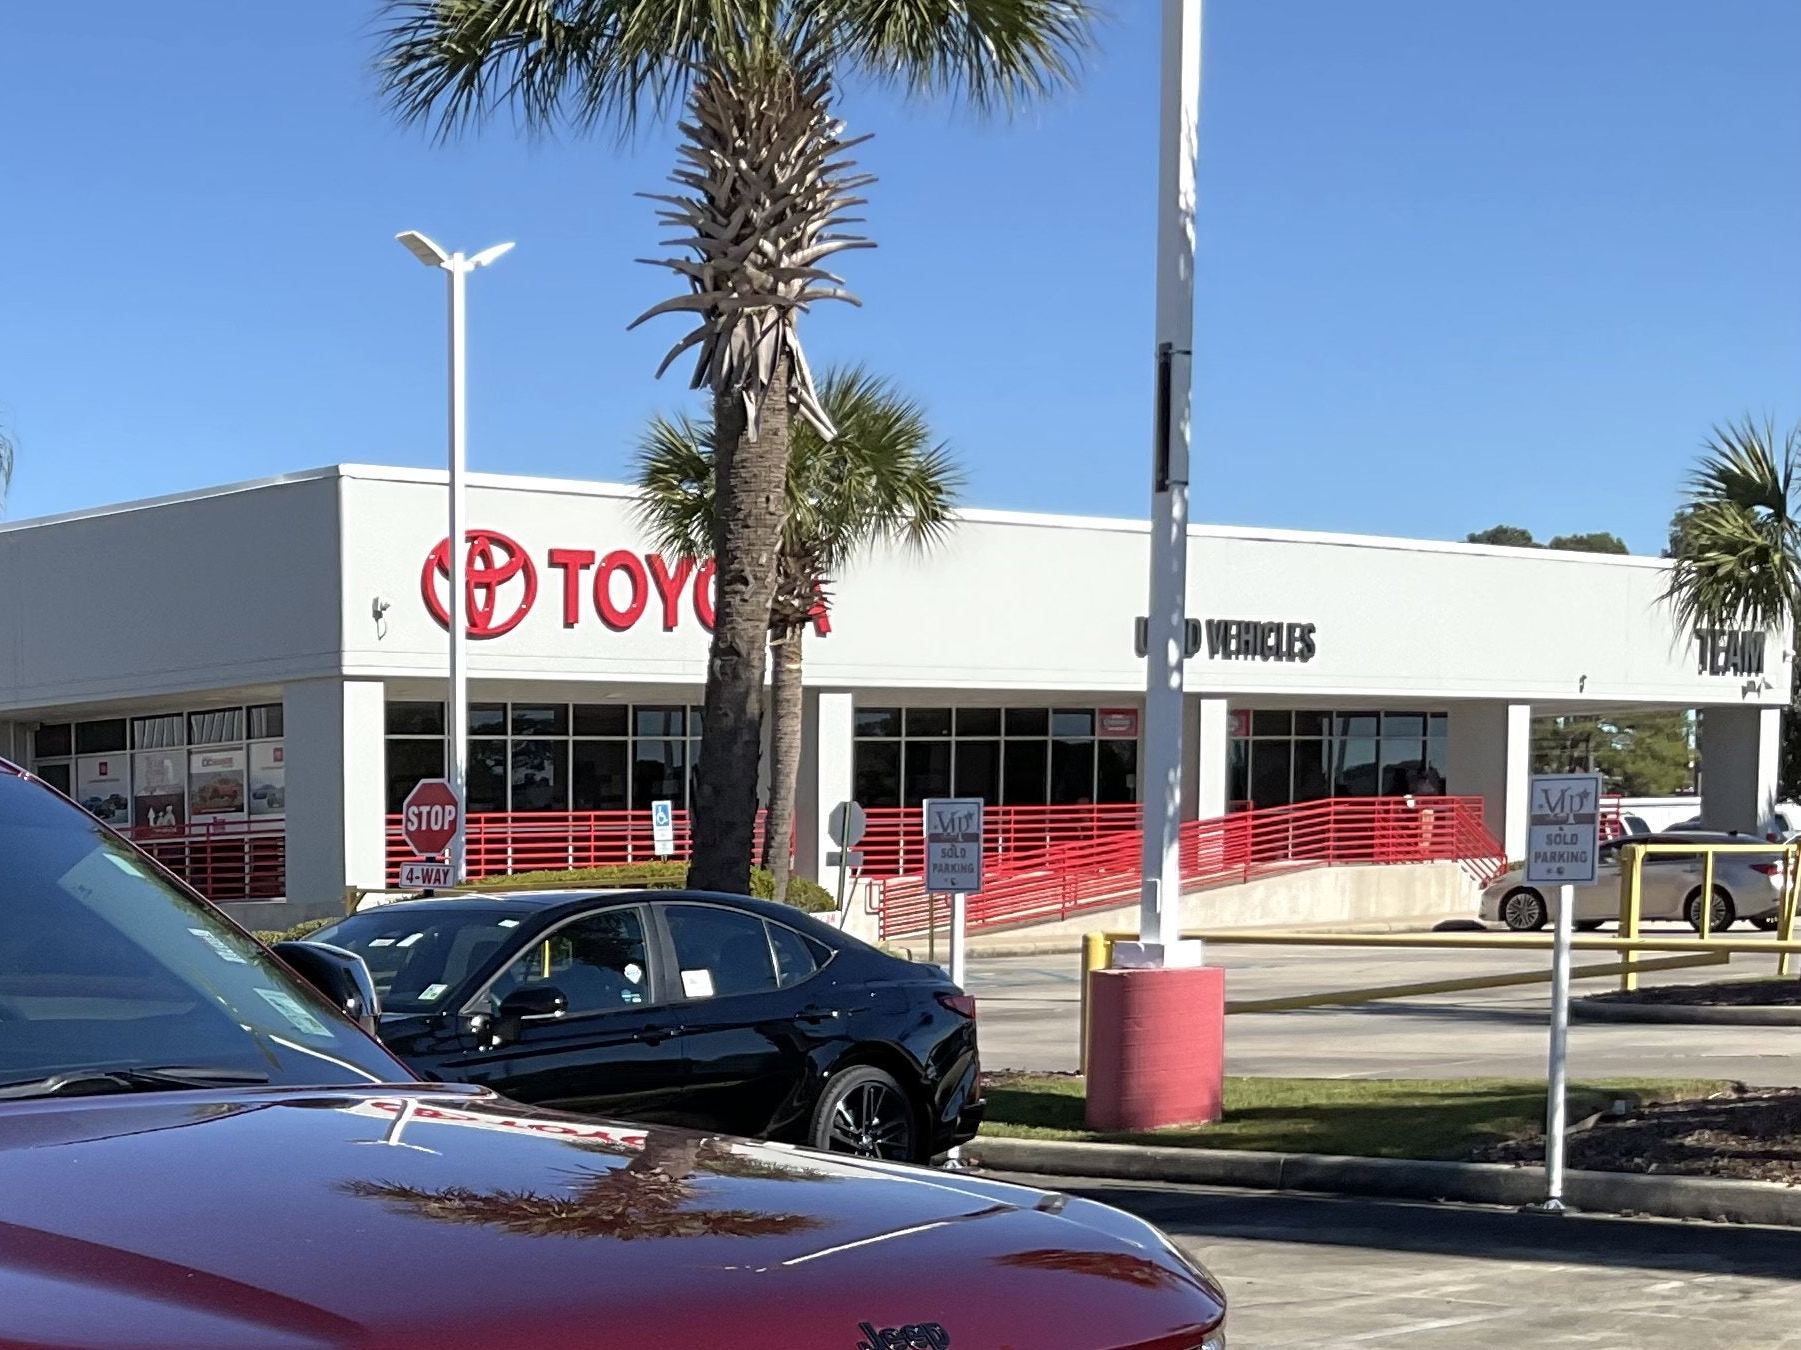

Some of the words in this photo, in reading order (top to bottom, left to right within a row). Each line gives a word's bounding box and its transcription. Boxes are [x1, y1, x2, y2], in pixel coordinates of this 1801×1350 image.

[1134, 616, 1202, 659] UD
[1205, 618, 1317, 663] VEHICLES
[1694, 628, 1766, 677] TEAM
[407, 804, 456, 832] STOP
[1545, 833, 1579, 846] SOLD
[941, 847, 967, 859] SOLD
[1534, 851, 1588, 864] PARKING
[406, 867, 450, 885] 4-WAY
[932, 863, 975, 874] PARKING
